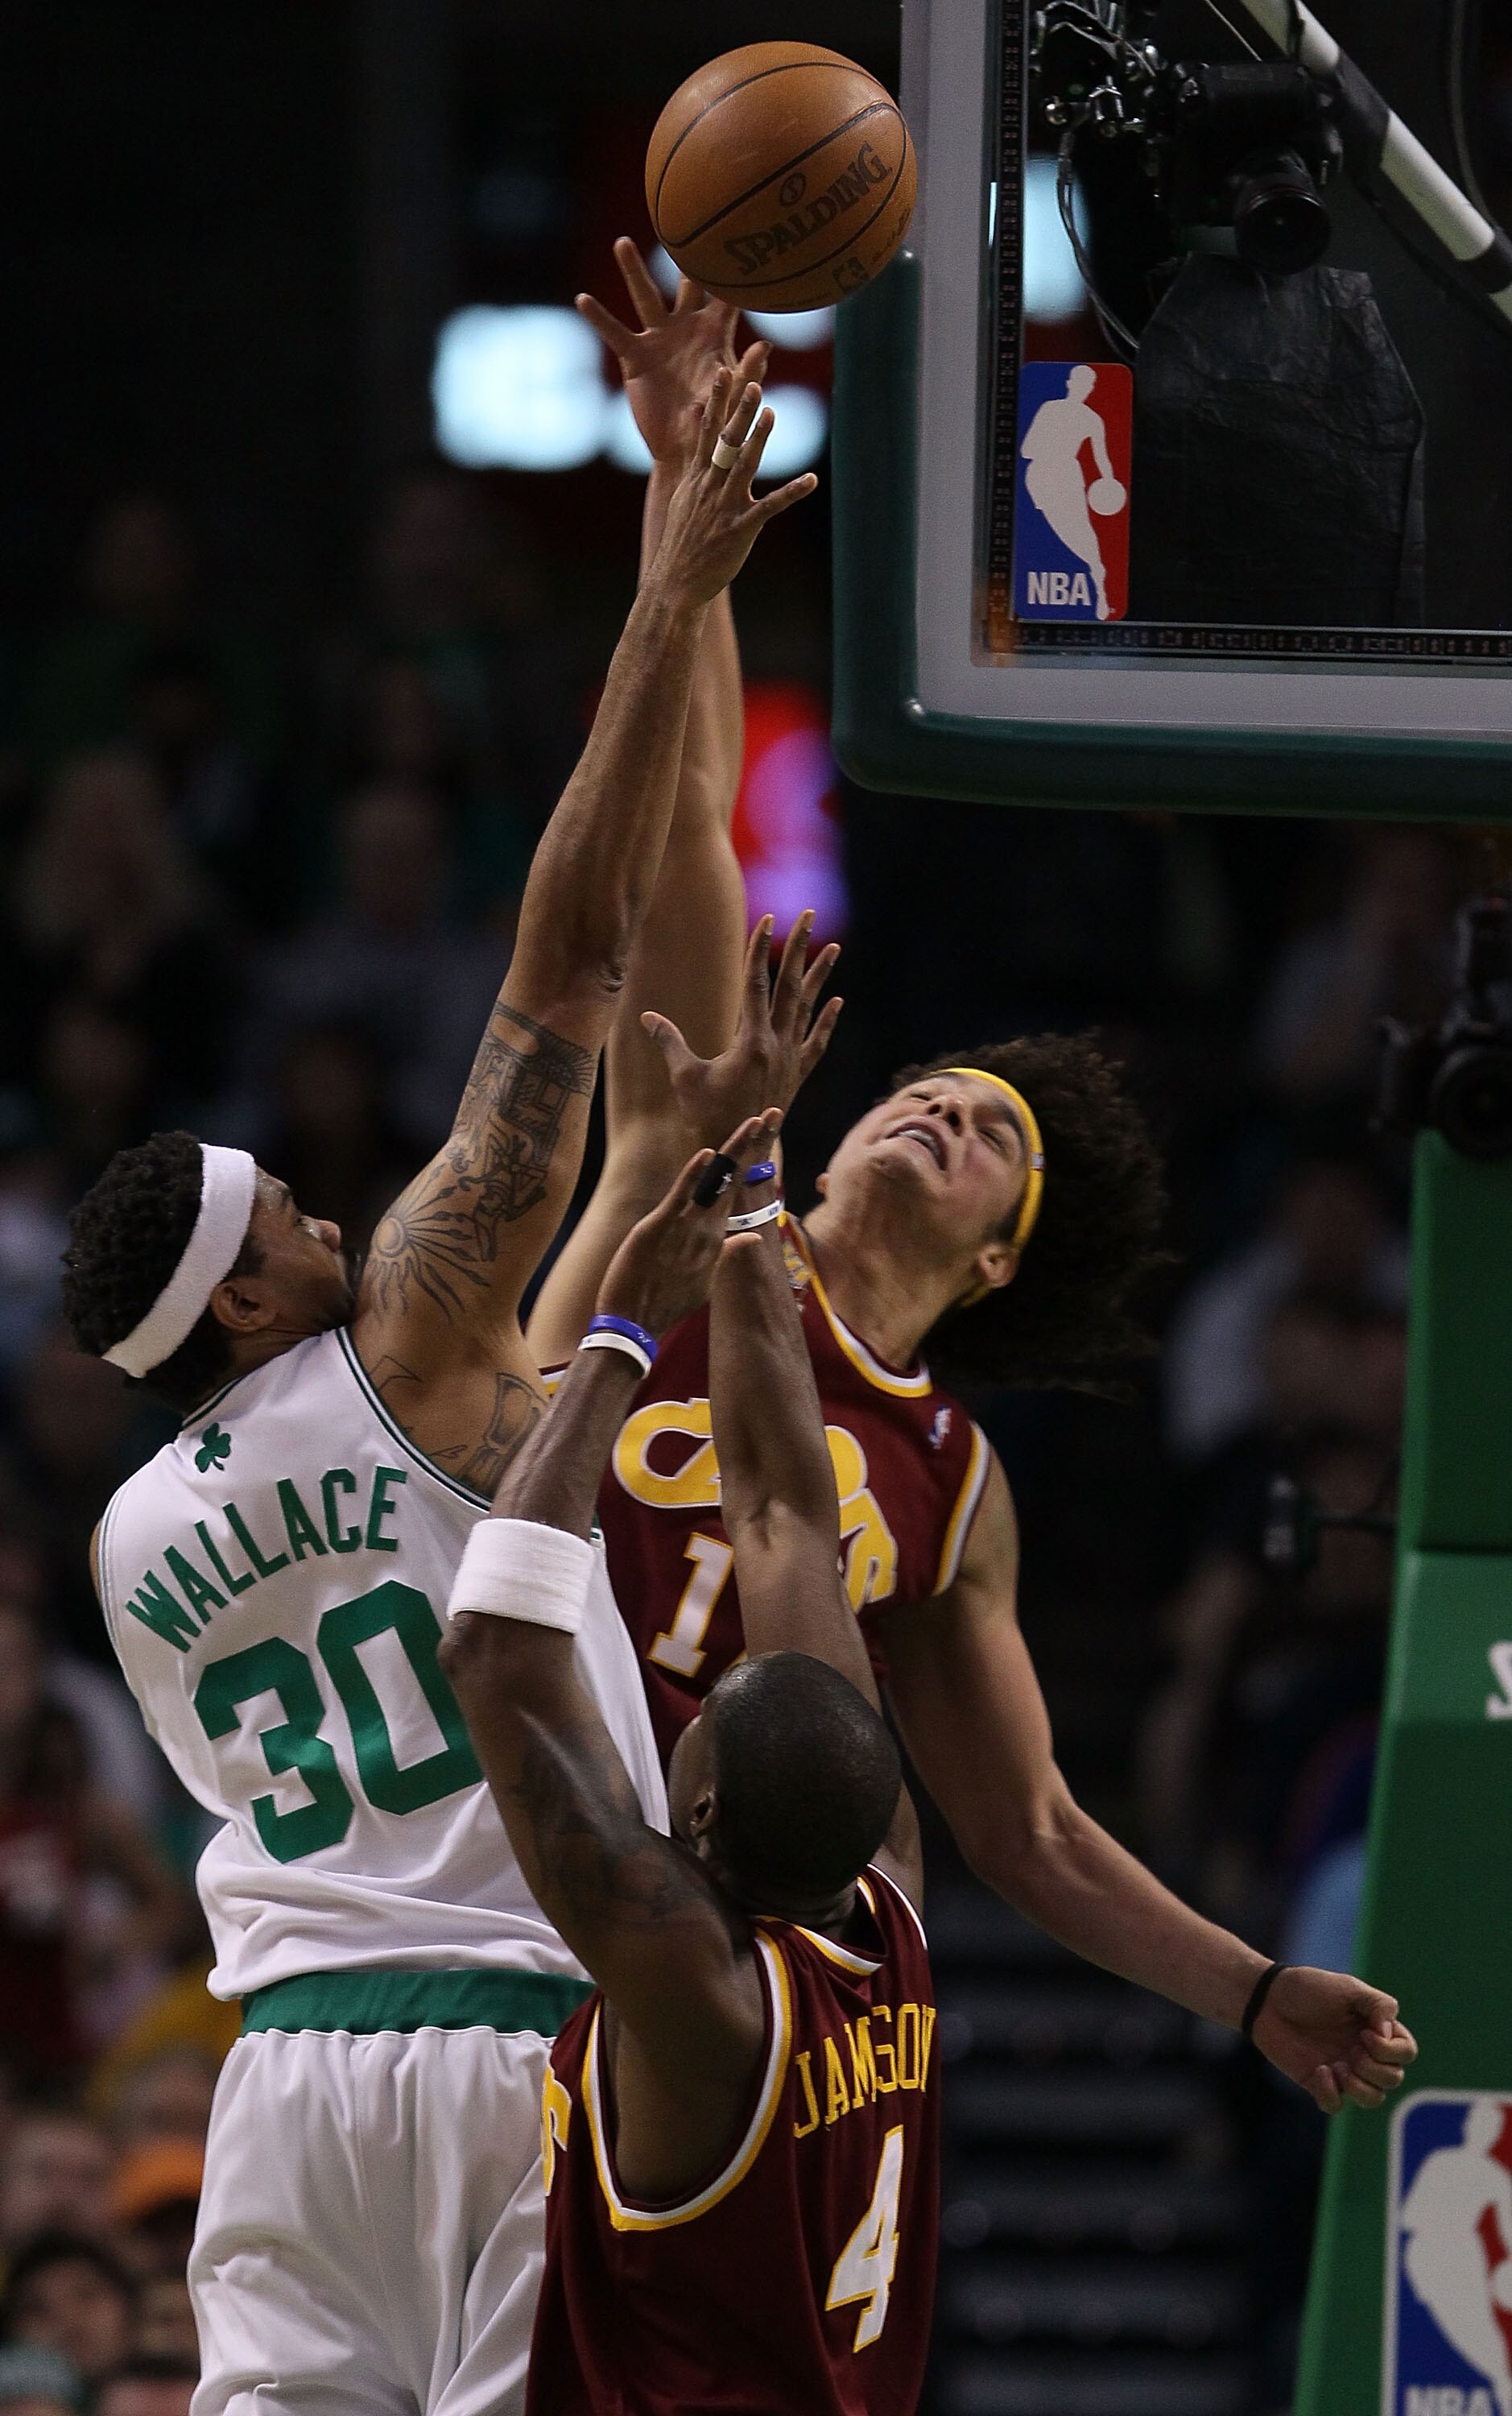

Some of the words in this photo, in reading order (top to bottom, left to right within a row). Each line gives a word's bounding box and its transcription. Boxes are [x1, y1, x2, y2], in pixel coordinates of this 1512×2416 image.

[723, 140, 893, 276] SPALDING
[1027, 571, 1092, 606] NBA
[126, 1465, 407, 1653] WALLACE
[648, 1532, 748, 1678] 1
[193, 1579, 485, 1864] 30
[824, 2124, 903, 2353] 4
